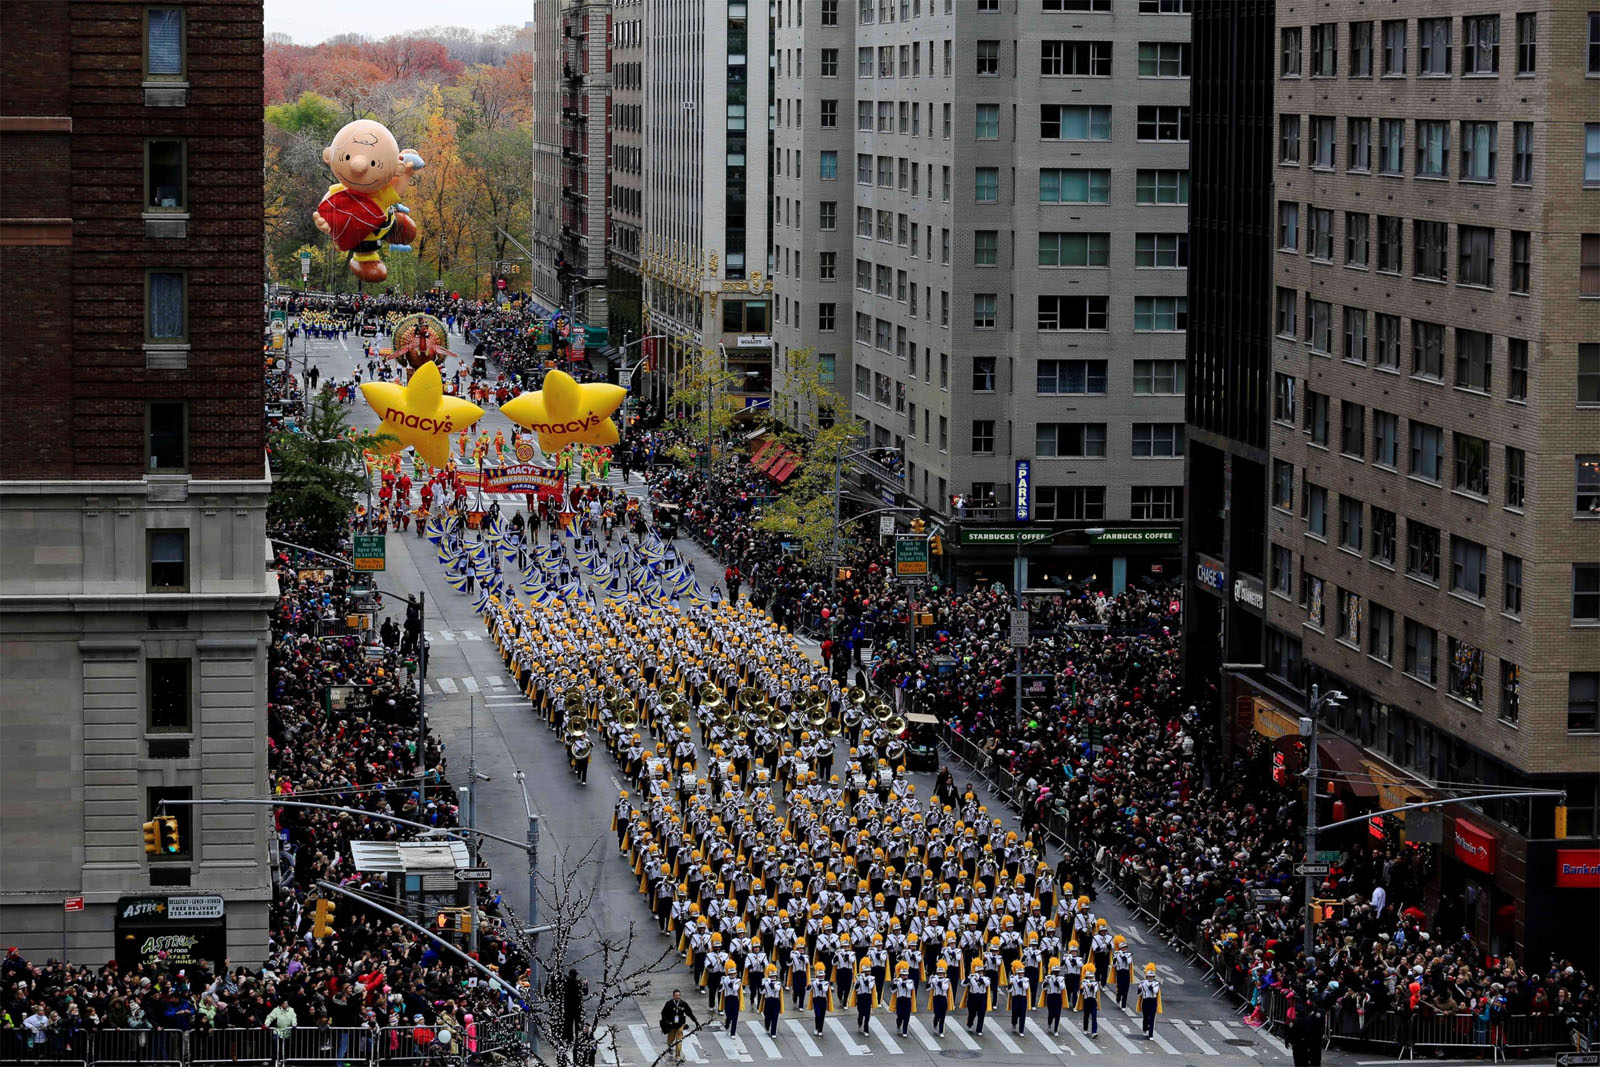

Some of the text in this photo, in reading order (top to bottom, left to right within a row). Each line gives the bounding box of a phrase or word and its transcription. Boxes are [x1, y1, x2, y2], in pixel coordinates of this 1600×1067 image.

[506, 466, 541, 475] MACY'S
[489, 475, 542, 486] THANKSGIVING
[543, 477, 557, 487] DAY
[1018, 469, 1028, 506] PARK
[1197, 564, 1217, 588] CHASE
[1562, 863, 1590, 875] Bank
[123, 903, 157, 918] ASTRO
[140, 935, 186, 954] ASTRO
